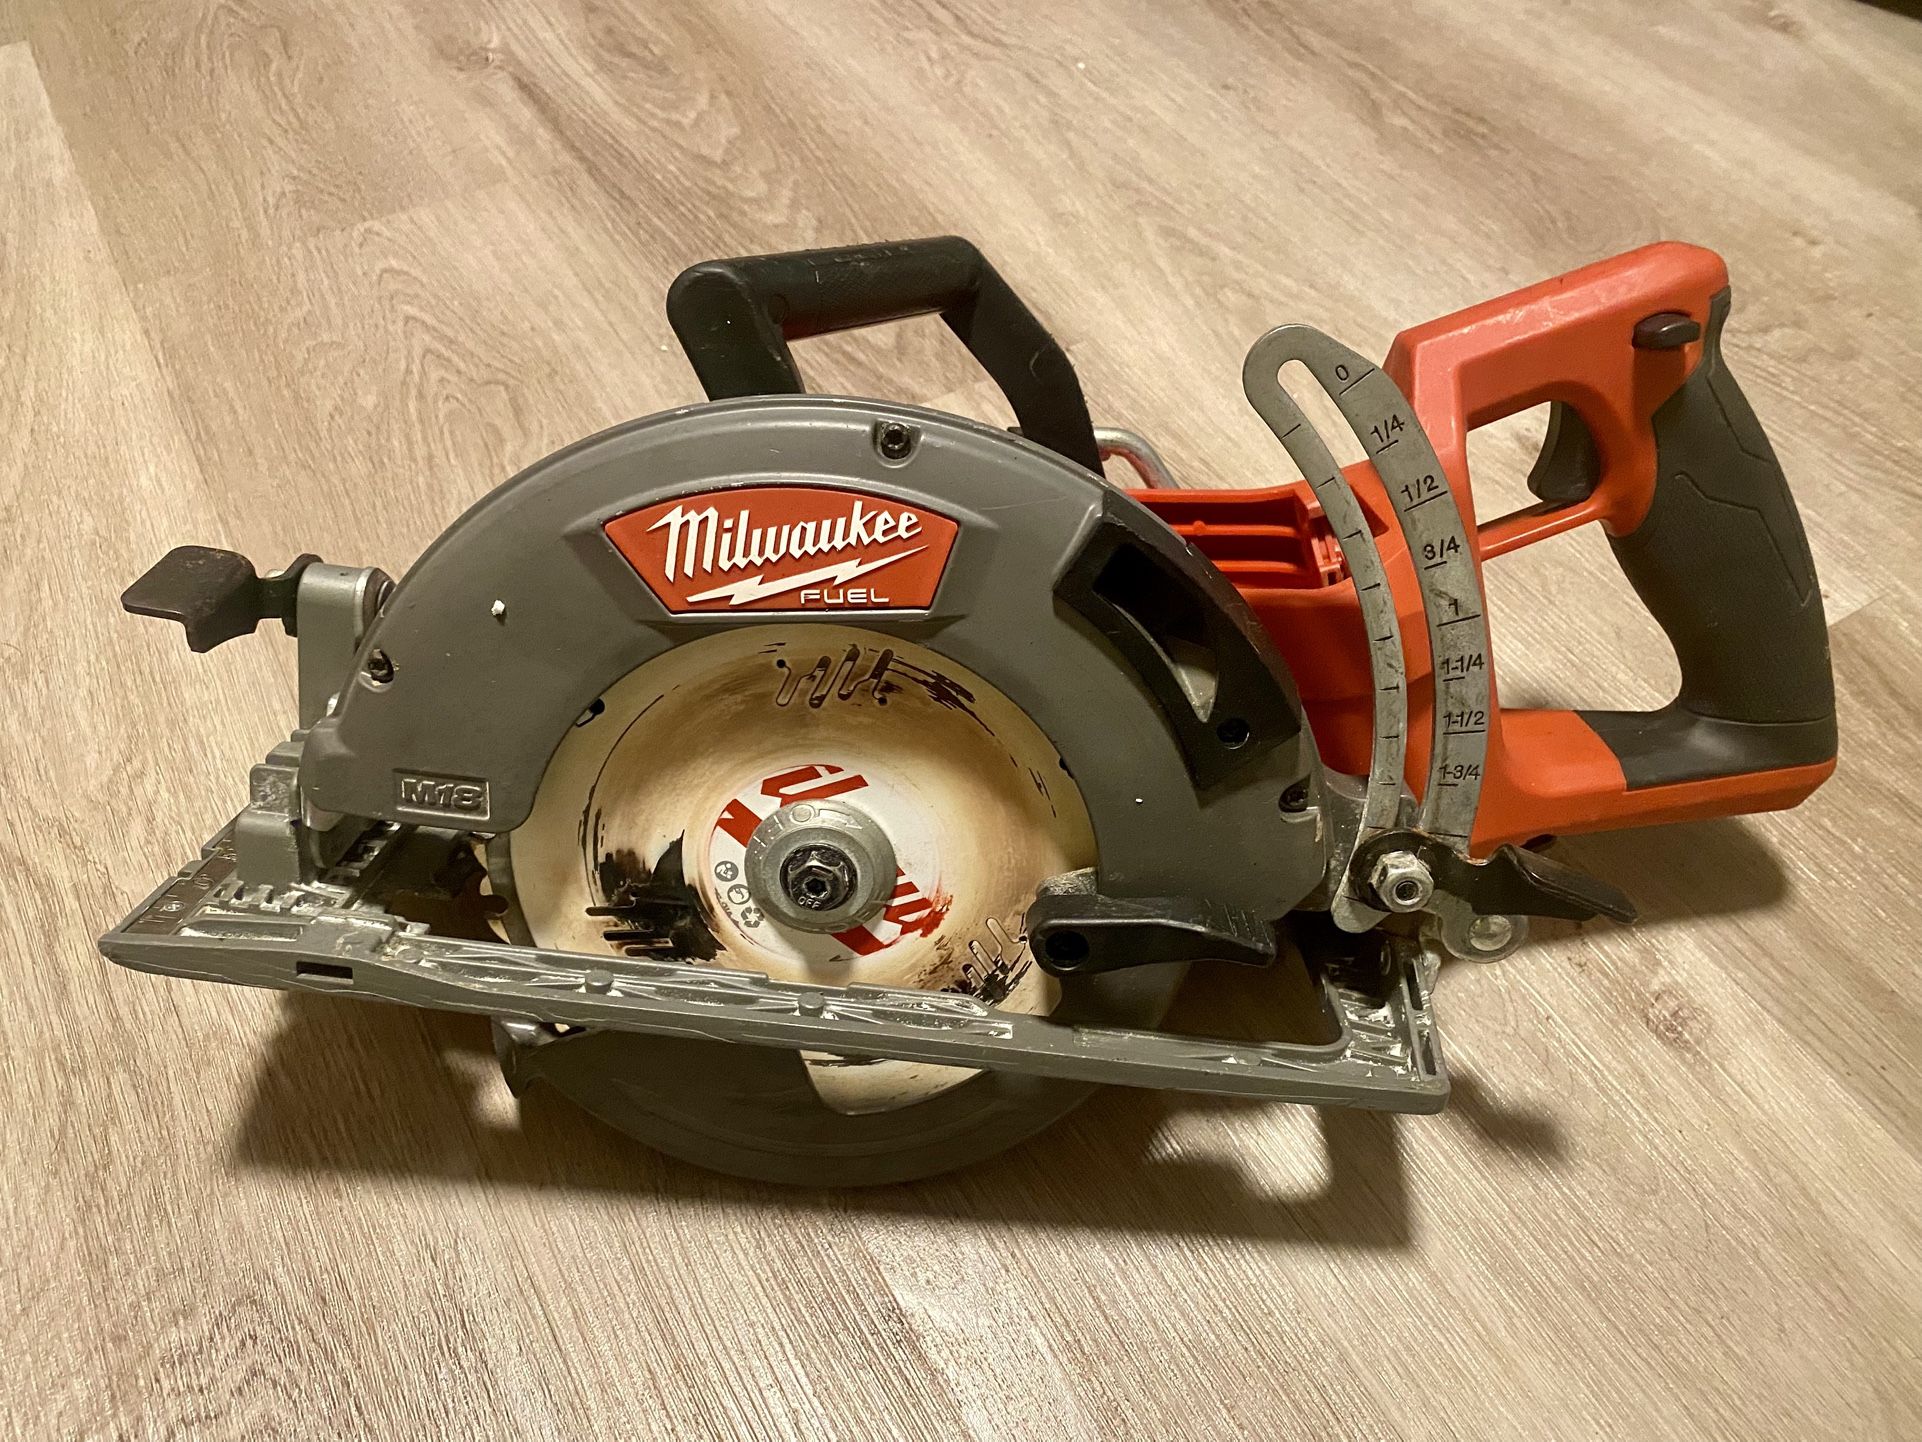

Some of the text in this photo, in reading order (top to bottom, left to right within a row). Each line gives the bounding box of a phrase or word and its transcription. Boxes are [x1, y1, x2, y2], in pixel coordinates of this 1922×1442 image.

[1335, 364, 1349, 381] 0
[1371, 414, 1405, 443] 1/4
[1401, 474, 1439, 502] 1/2
[646, 501, 923, 583] Milwaukee
[1423, 536, 1460, 560] 3/4
[800, 588, 889, 605] FUEL
[1448, 599, 1459, 615] 1
[1441, 653, 1484, 673] 1-1/4
[1443, 711, 1485, 729] 1-1/2
[1439, 764, 1481, 781] 1-3/4
[401, 778, 483, 811] M18
[798, 896, 821, 909] OFF
